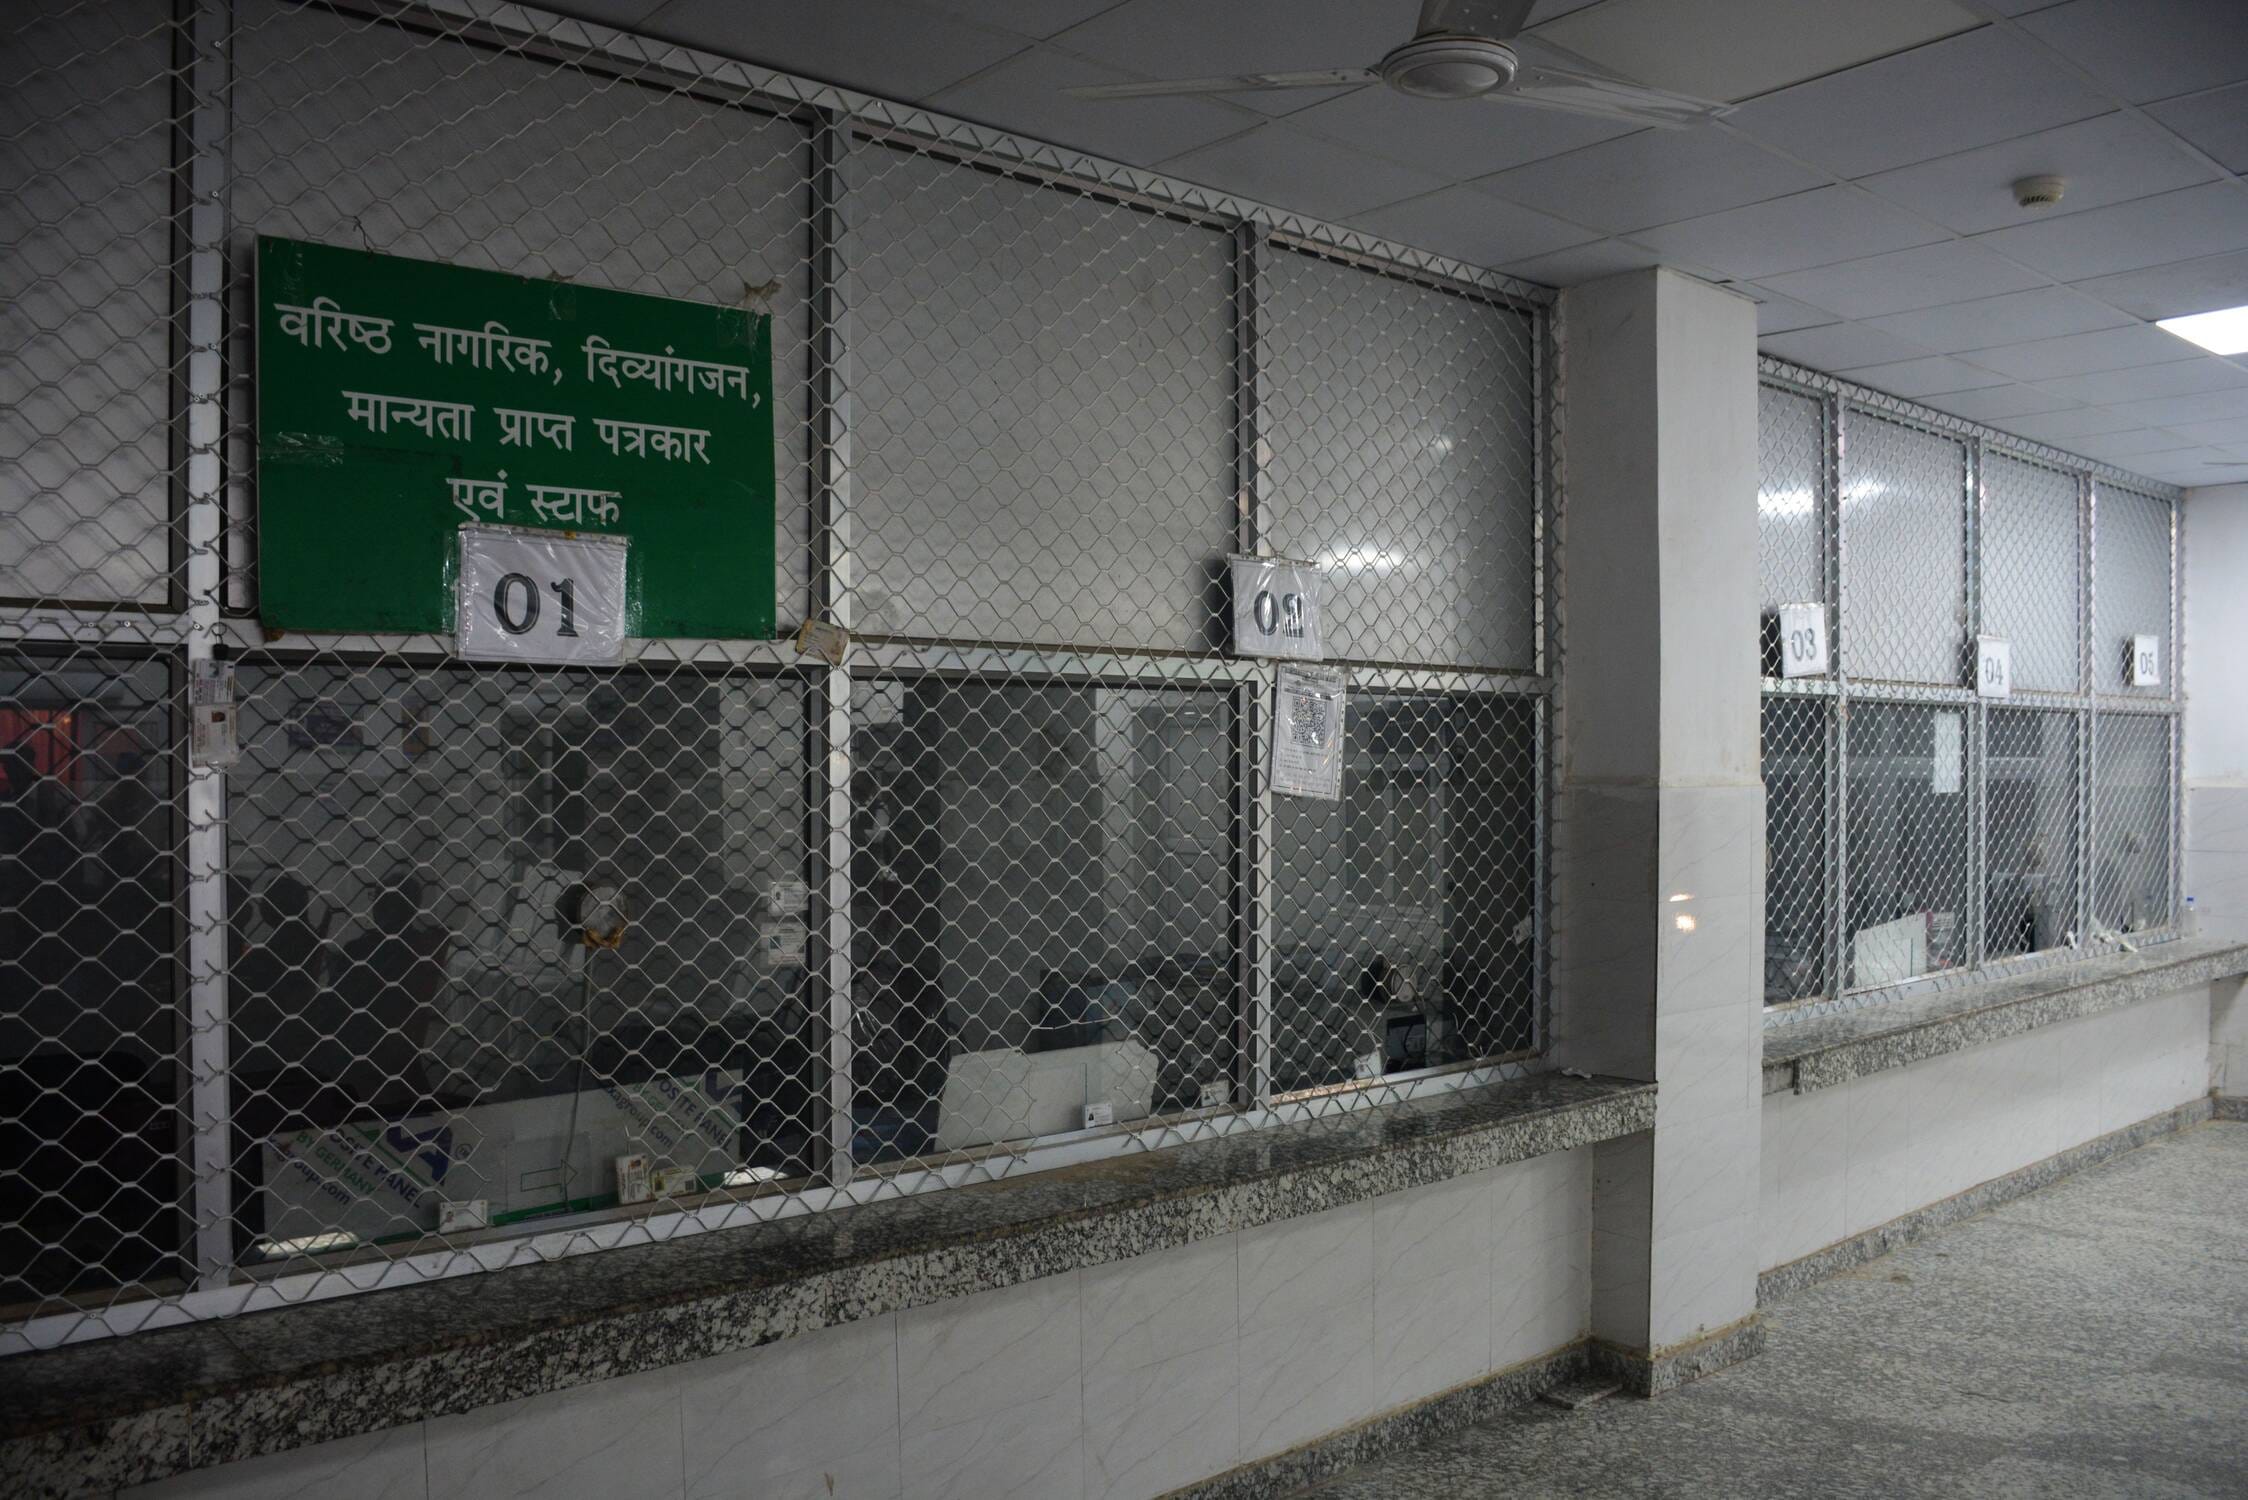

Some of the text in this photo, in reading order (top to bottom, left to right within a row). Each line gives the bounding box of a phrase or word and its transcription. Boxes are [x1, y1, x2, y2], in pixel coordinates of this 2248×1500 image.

[274, 297, 761, 408] वरिष्ठ नागरिक, दिव्यांगजन,
[342, 390, 711, 465] मान्यता प्राप्त पत्रकार
[446, 470, 622, 526] एवं स्टाफ
[494, 572, 580, 637] 01
[1791, 627, 1817, 662] 03
[1985, 657, 2004, 686] 04
